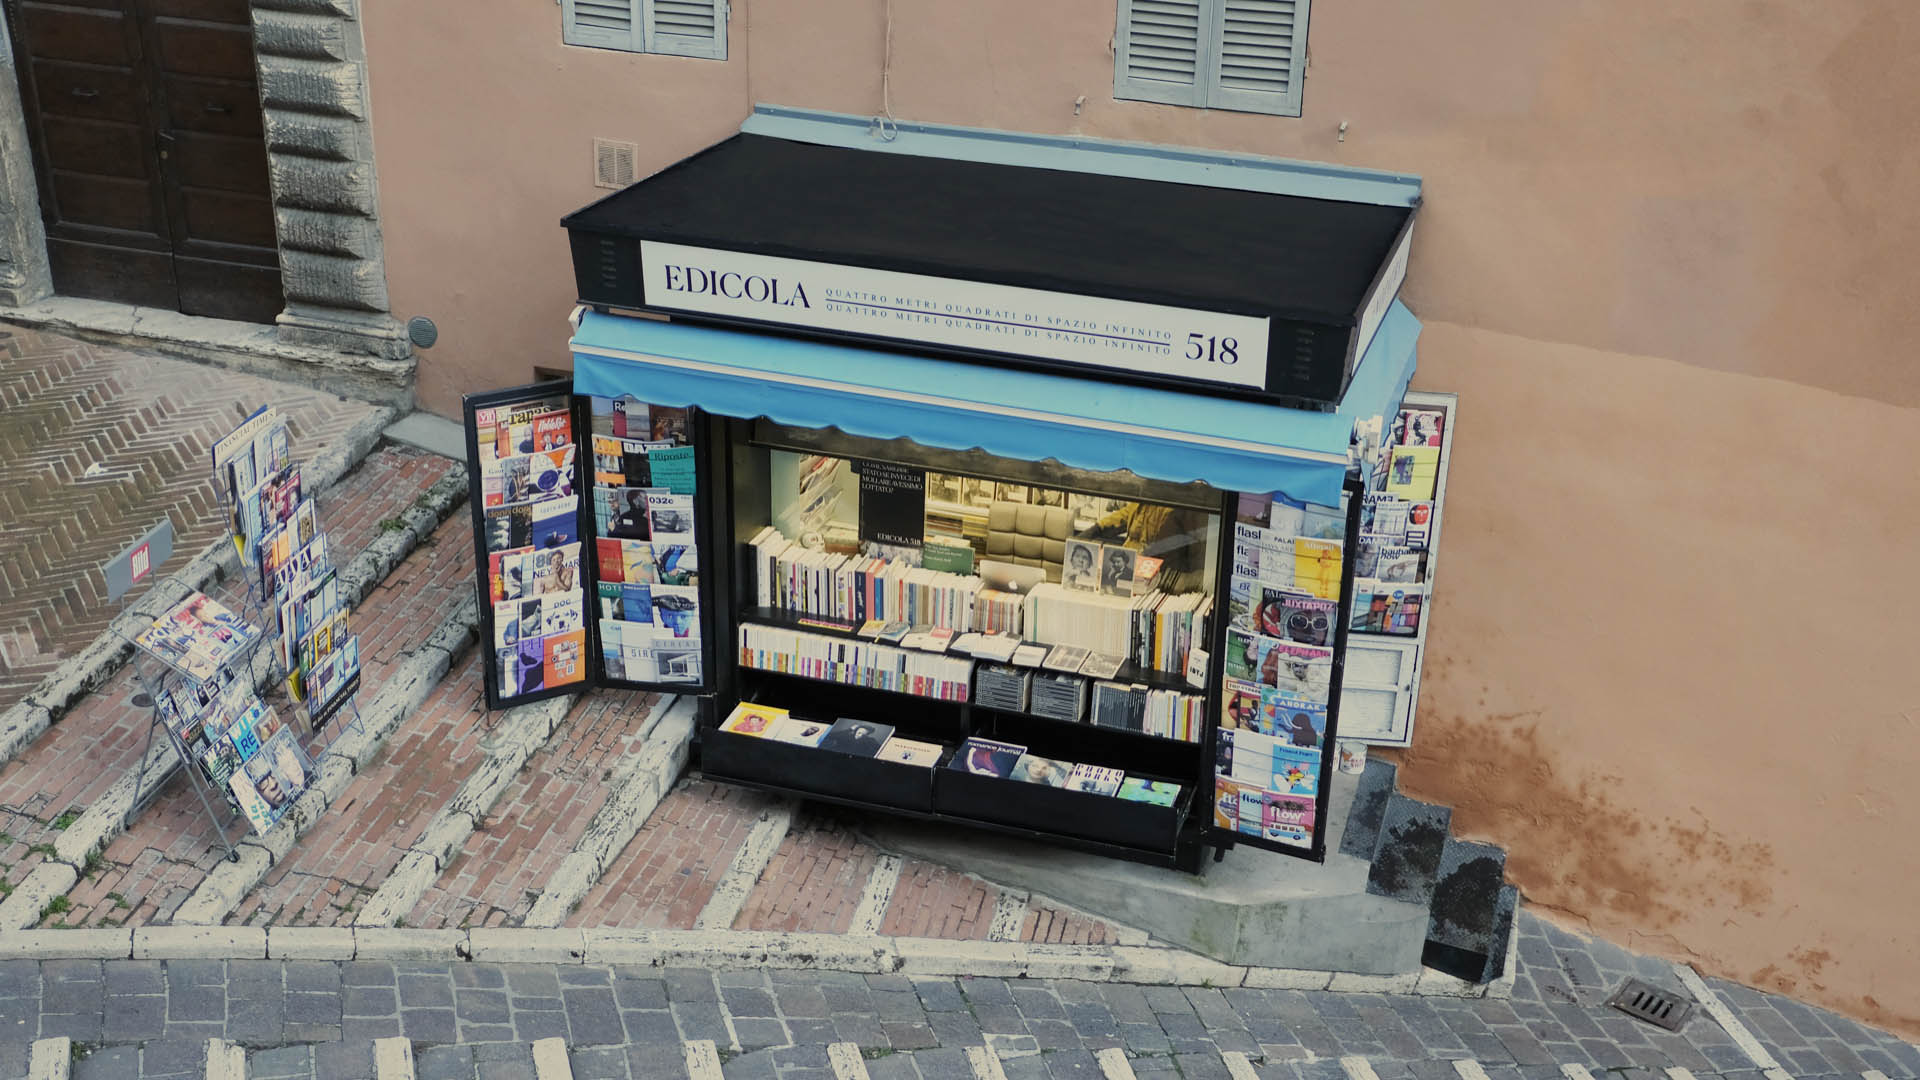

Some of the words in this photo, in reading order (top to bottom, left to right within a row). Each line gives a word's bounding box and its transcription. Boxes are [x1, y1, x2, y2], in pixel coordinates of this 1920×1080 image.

[665, 264, 810, 308] EDICOLA
[825, 287, 887, 304] QUATTRO
[895, 297, 938, 310] METRI
[945, 303, 1016, 321] QUADRATI
[1024, 312, 1039, 323] DI
[1047, 316, 1097, 331] SPAZIO
[1104, 325, 1172, 341] INFINITO
[826, 303, 888, 319] QUATTRO
[895, 312, 938, 325] METRI
[945, 318, 1016, 335] QUADRATI
[1024, 327, 1039, 338] DI
[1047, 331, 1097, 346] SPAZIO
[1104, 338, 1171, 356] INFINITO
[1185, 332, 1239, 365] 518
[877, 531, 909, 545] EDICOLA
[1281, 599, 1335, 612] JUXTAPOZ
[1077, 764, 1122, 777] PHOTO
